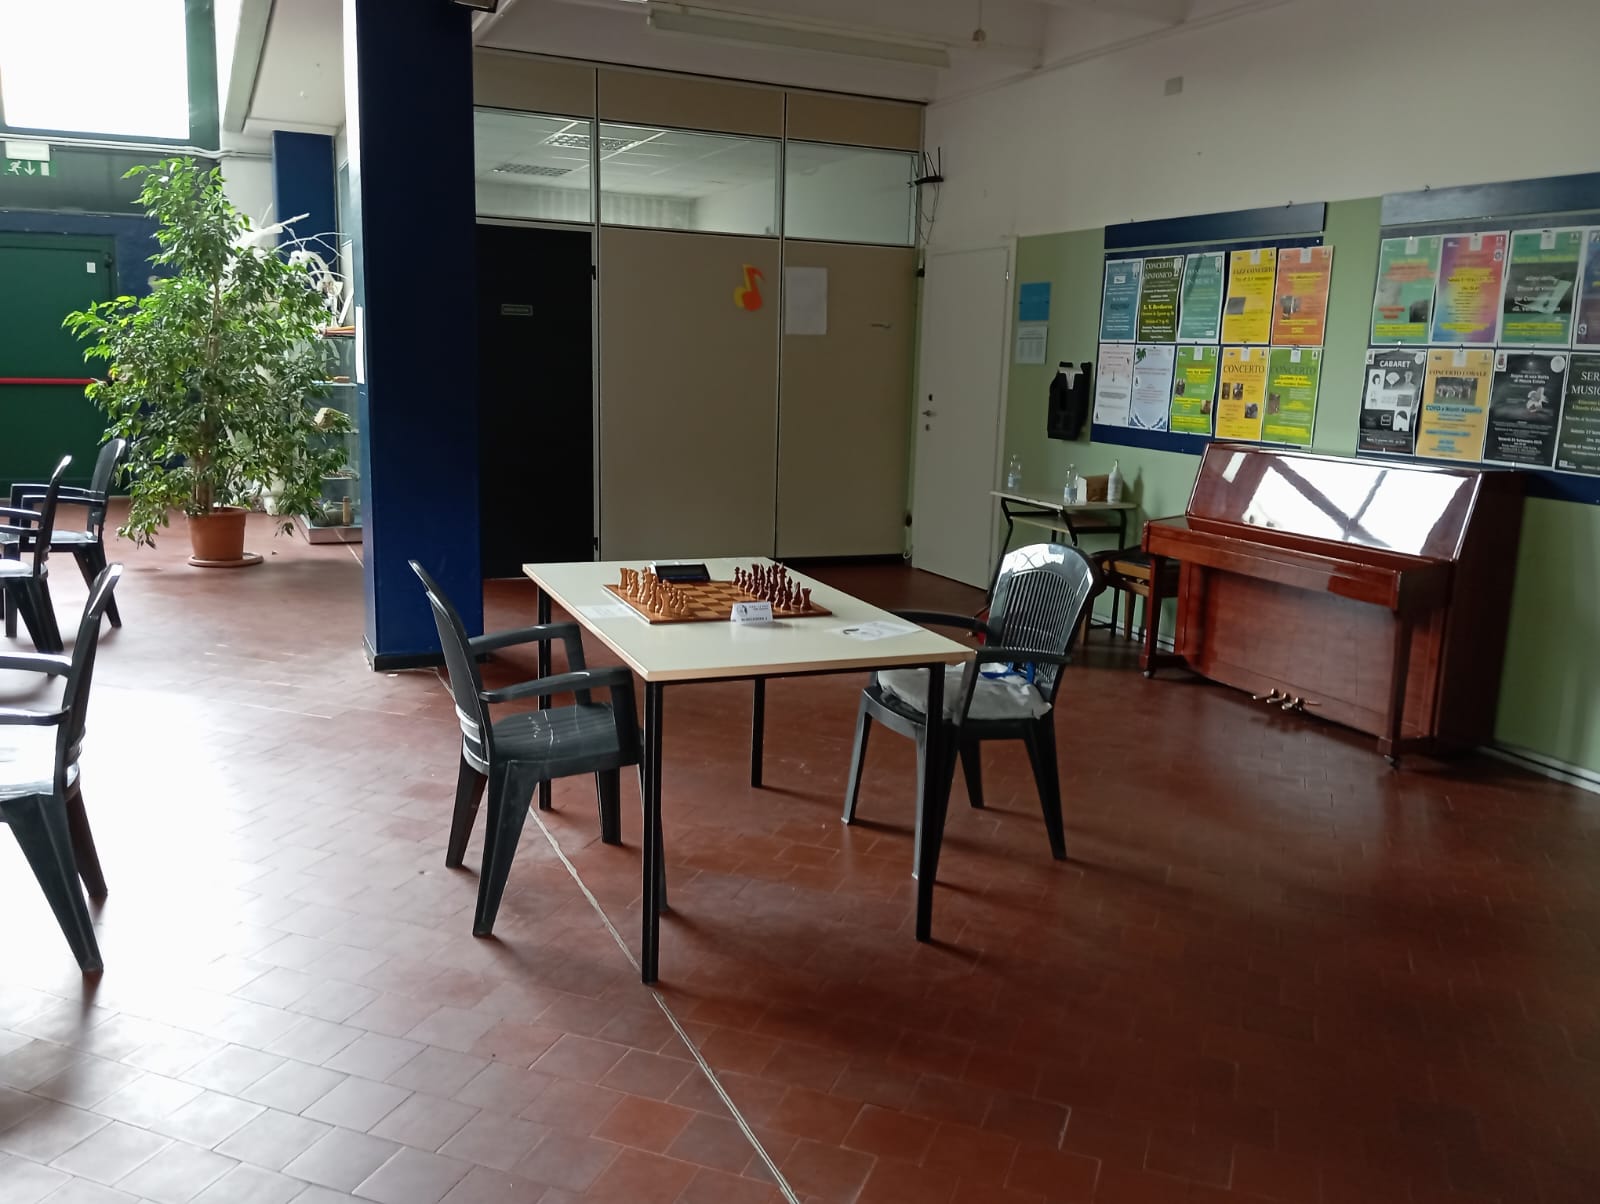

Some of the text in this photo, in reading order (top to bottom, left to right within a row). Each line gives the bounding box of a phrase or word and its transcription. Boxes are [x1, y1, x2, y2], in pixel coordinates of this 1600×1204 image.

[1145, 262, 1173, 270] CONCERTO
[1379, 360, 1411, 368] CABARET
[1223, 364, 1265, 374] CONCERTO
